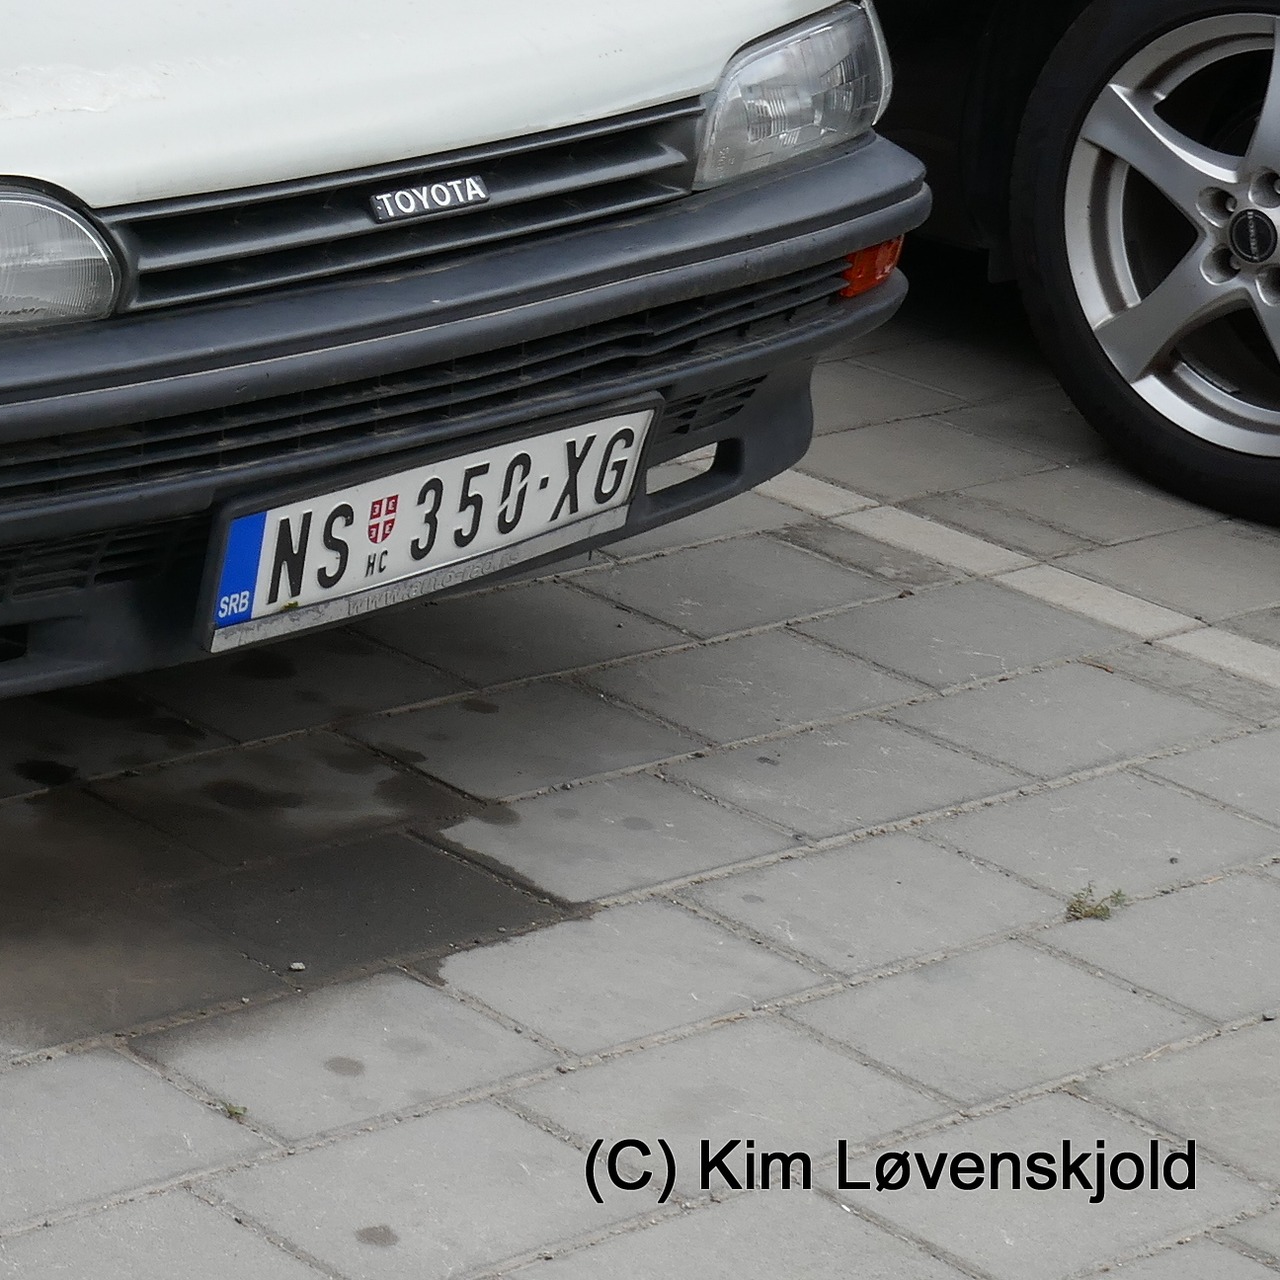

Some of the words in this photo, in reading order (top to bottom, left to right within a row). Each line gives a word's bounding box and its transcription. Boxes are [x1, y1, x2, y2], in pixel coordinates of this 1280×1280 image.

[377, 178, 486, 218] TOYOTA
[265, 502, 355, 605] NS
[409, 426, 636, 562] 350-XG
[217, 589, 250, 619] SRB
